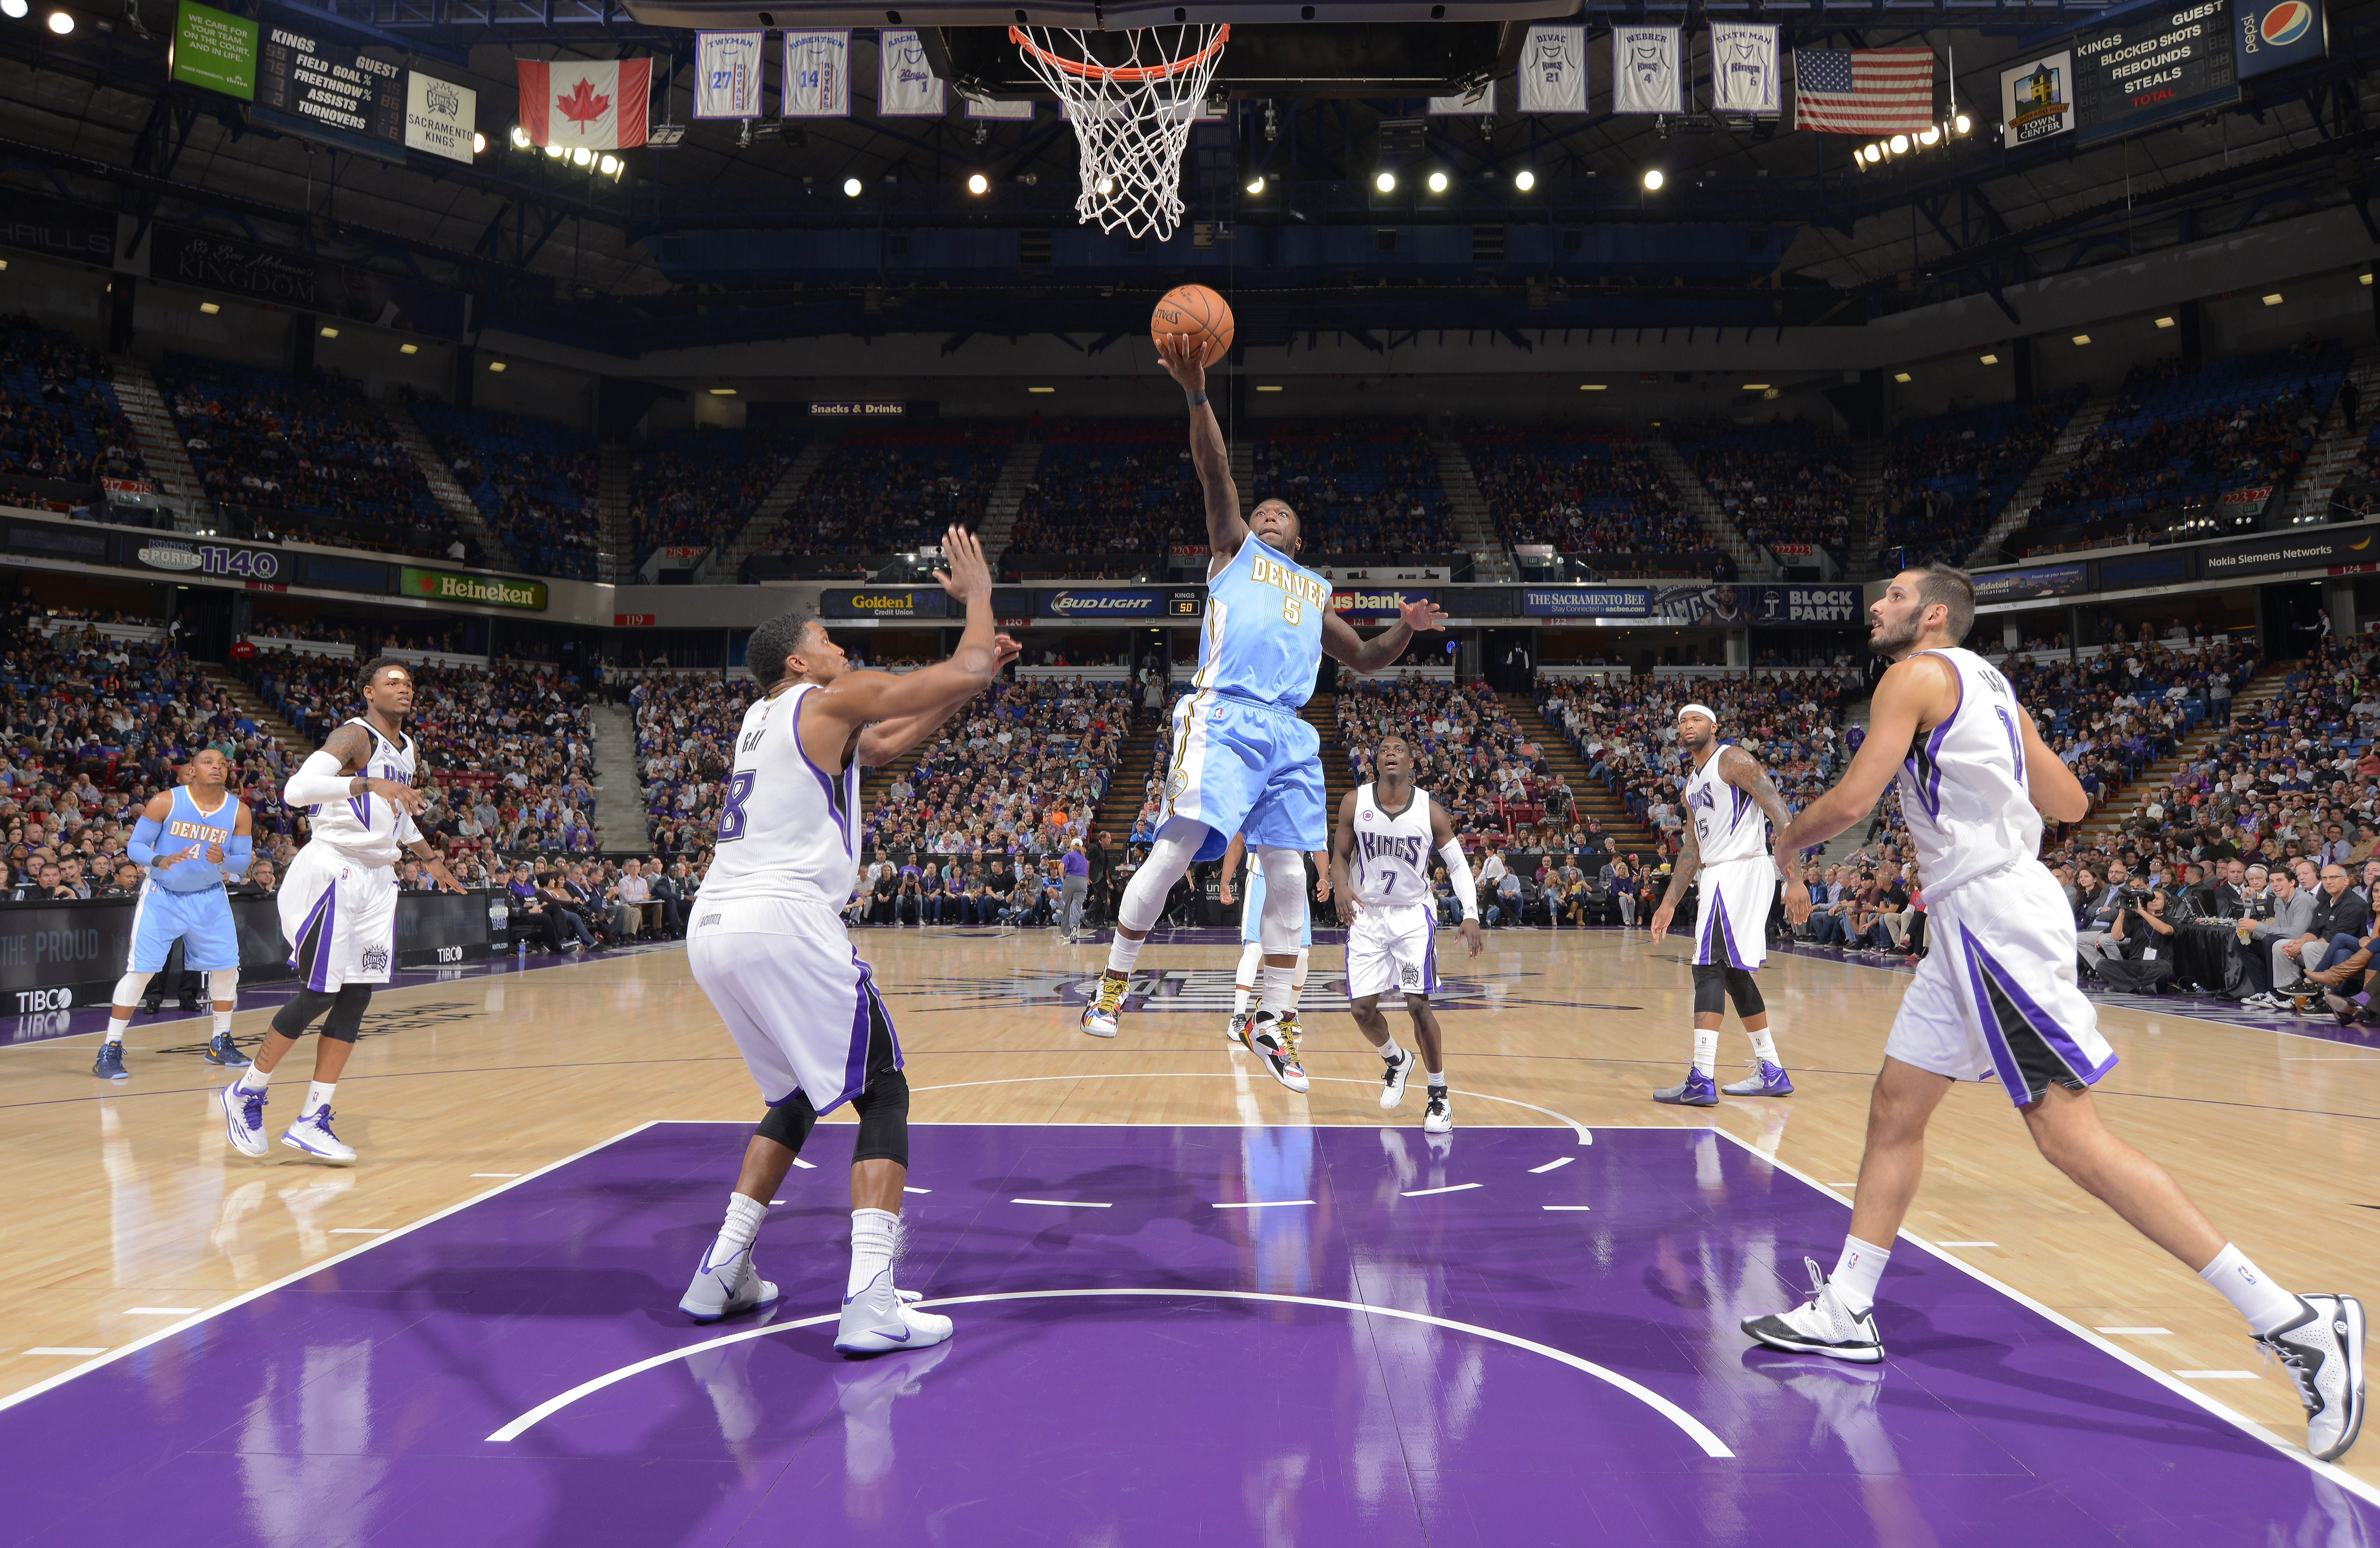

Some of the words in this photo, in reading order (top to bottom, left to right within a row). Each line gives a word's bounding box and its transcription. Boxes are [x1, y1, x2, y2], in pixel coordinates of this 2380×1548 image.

[2172, 1, 2224, 25] GUEST
[189, 14, 203, 24] WE
[205, 19, 228, 32] CARE
[231, 27, 247, 38] FOR
[191, 24, 215, 36] YOUR
[218, 31, 244, 45] TEAM.
[184, 31, 197, 40] ON
[201, 35, 217, 46] THE
[219, 41, 249, 57] COURT,
[271, 29, 315, 53] KINGS
[707, 38, 754, 48] TWYMAN
[789, 36, 845, 50] ROBERTSON
[888, 35, 920, 48] ARCHI
[1536, 34, 1566, 43] DIVAC
[1626, 33, 1667, 43] WEBBER
[1717, 32, 1745, 43] SIXTH
[1749, 32, 1771, 45] MAN
[2077, 34, 2122, 57] KINGS
[2101, 38, 2157, 66] BLOCKED
[2159, 24, 2202, 46] SHOTS
[190, 42, 209, 52] AND
[224, 51, 243, 62] LIFE.
[296, 54, 328, 72] FIELD
[333, 65, 361, 83] GOAL
[363, 74, 372, 86] %
[355, 56, 398, 78] GUEST
[1731, 62, 1760, 76] Kings
[2112, 45, 2191, 80] REBOUNDS
[226, 77, 247, 87] thrive
[712, 71, 731, 89] 27
[801, 70, 818, 88] 14
[897, 69, 927, 81] Kings
[1545, 72, 1559, 82] 21
[1643, 74, 1652, 83] 4
[1750, 77, 1757, 86] 6
[2124, 67, 2181, 94] STEALS
[294, 68, 363, 98] FREETHROW
[363, 89, 371, 101] %
[922, 81, 927, 92] 1
[307, 88, 357, 111] ASSISTS
[2132, 88, 2176, 107] TOTAL
[298, 100, 366, 129] TURNOVERS
[2011, 118, 2020, 127] EL
[2019, 107, 2047, 122] DORADO
[2050, 104, 2068, 114] HILLS
[2022, 114, 2056, 130] TOWN
[409, 114, 472, 141] SACRAMENTO
[2020, 121, 2060, 140] CENTER
[426, 131, 454, 148] KINGS
[213, 245, 244, 260] Ben
[179, 256, 315, 303] KINGDOM
[811, 404, 849, 413] Snacks
[852, 404, 861, 413] &
[865, 404, 902, 413] Drinks
[102, 479, 122, 492] 217
[130, 483, 152, 494] 218
[2225, 492, 2248, 505] 223
[149, 539, 193, 553] KHTK
[667, 548, 683, 558] 218
[687, 548, 704, 558] 219
[1171, 547, 1189, 556] 220
[1193, 547, 1208, 556] 221
[1775, 546, 1791, 555] 222
[1794, 546, 1812, 555] 223
[138, 548, 203, 567] SPORTS
[199, 546, 278, 578] 1140
[2209, 557, 2236, 567] Nokia
[2238, 552, 2280, 564] Siemens
[2283, 546, 2332, 559] Networks
[2342, 565, 2360, 574] 124
[259, 583, 274, 591] 118
[441, 577, 533, 604] Heineken
[1251, 554, 1327, 612] DENVER
[1059, 598, 1098, 608] BUD
[1098, 598, 1152, 608] LIGHT
[1528, 594, 1550, 605] THE
[1552, 594, 1623, 605] SACRAMENTO
[1624, 594, 1645, 605] BEE
[1789, 591, 1852, 605] BLOCK
[1180, 603, 1192, 612] 50
[1283, 594, 1302, 626] 5
[1552, 605, 1565, 613] Stay
[1790, 607, 1852, 621] PARTY
[627, 615, 643, 625] 119
[741, 729, 766, 754] GAY
[717, 769, 756, 844] 8
[169, 819, 228, 845] DENVER
[1694, 818, 1710, 842] 15
[188, 842, 202, 860] 4
[1360, 831, 1422, 870] KINGS
[1381, 870, 1397, 895] 7
[489, 907, 509, 916] SPORTS
[492, 918, 507, 930] 1140
[0, 935, 27, 966] THE
[36, 929, 99, 963] PROUD
[437, 946, 462, 963] TIBCO
[363, 954, 388, 969] KINGS
[1402, 970, 1418, 984] KINGS
[16, 988, 72, 1013] TIBCO
